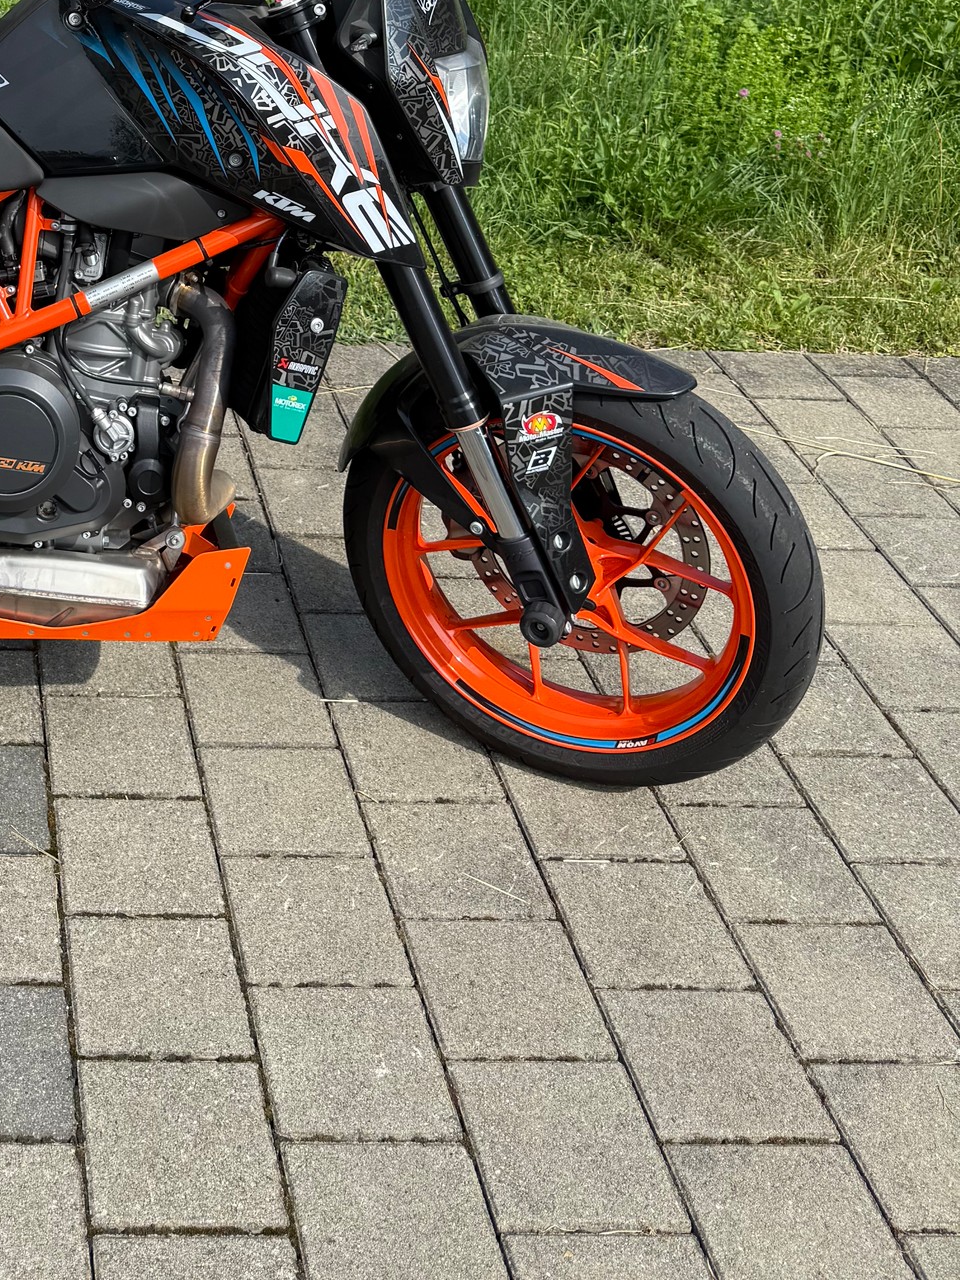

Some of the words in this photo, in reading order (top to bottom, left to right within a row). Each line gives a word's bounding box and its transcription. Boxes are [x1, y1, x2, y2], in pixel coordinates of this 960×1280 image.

[253, 189, 317, 223] KTM
[274, 397, 307, 410] MOTOREX
[16, 460, 46, 473] KTM
[617, 739, 648, 748] AVON
